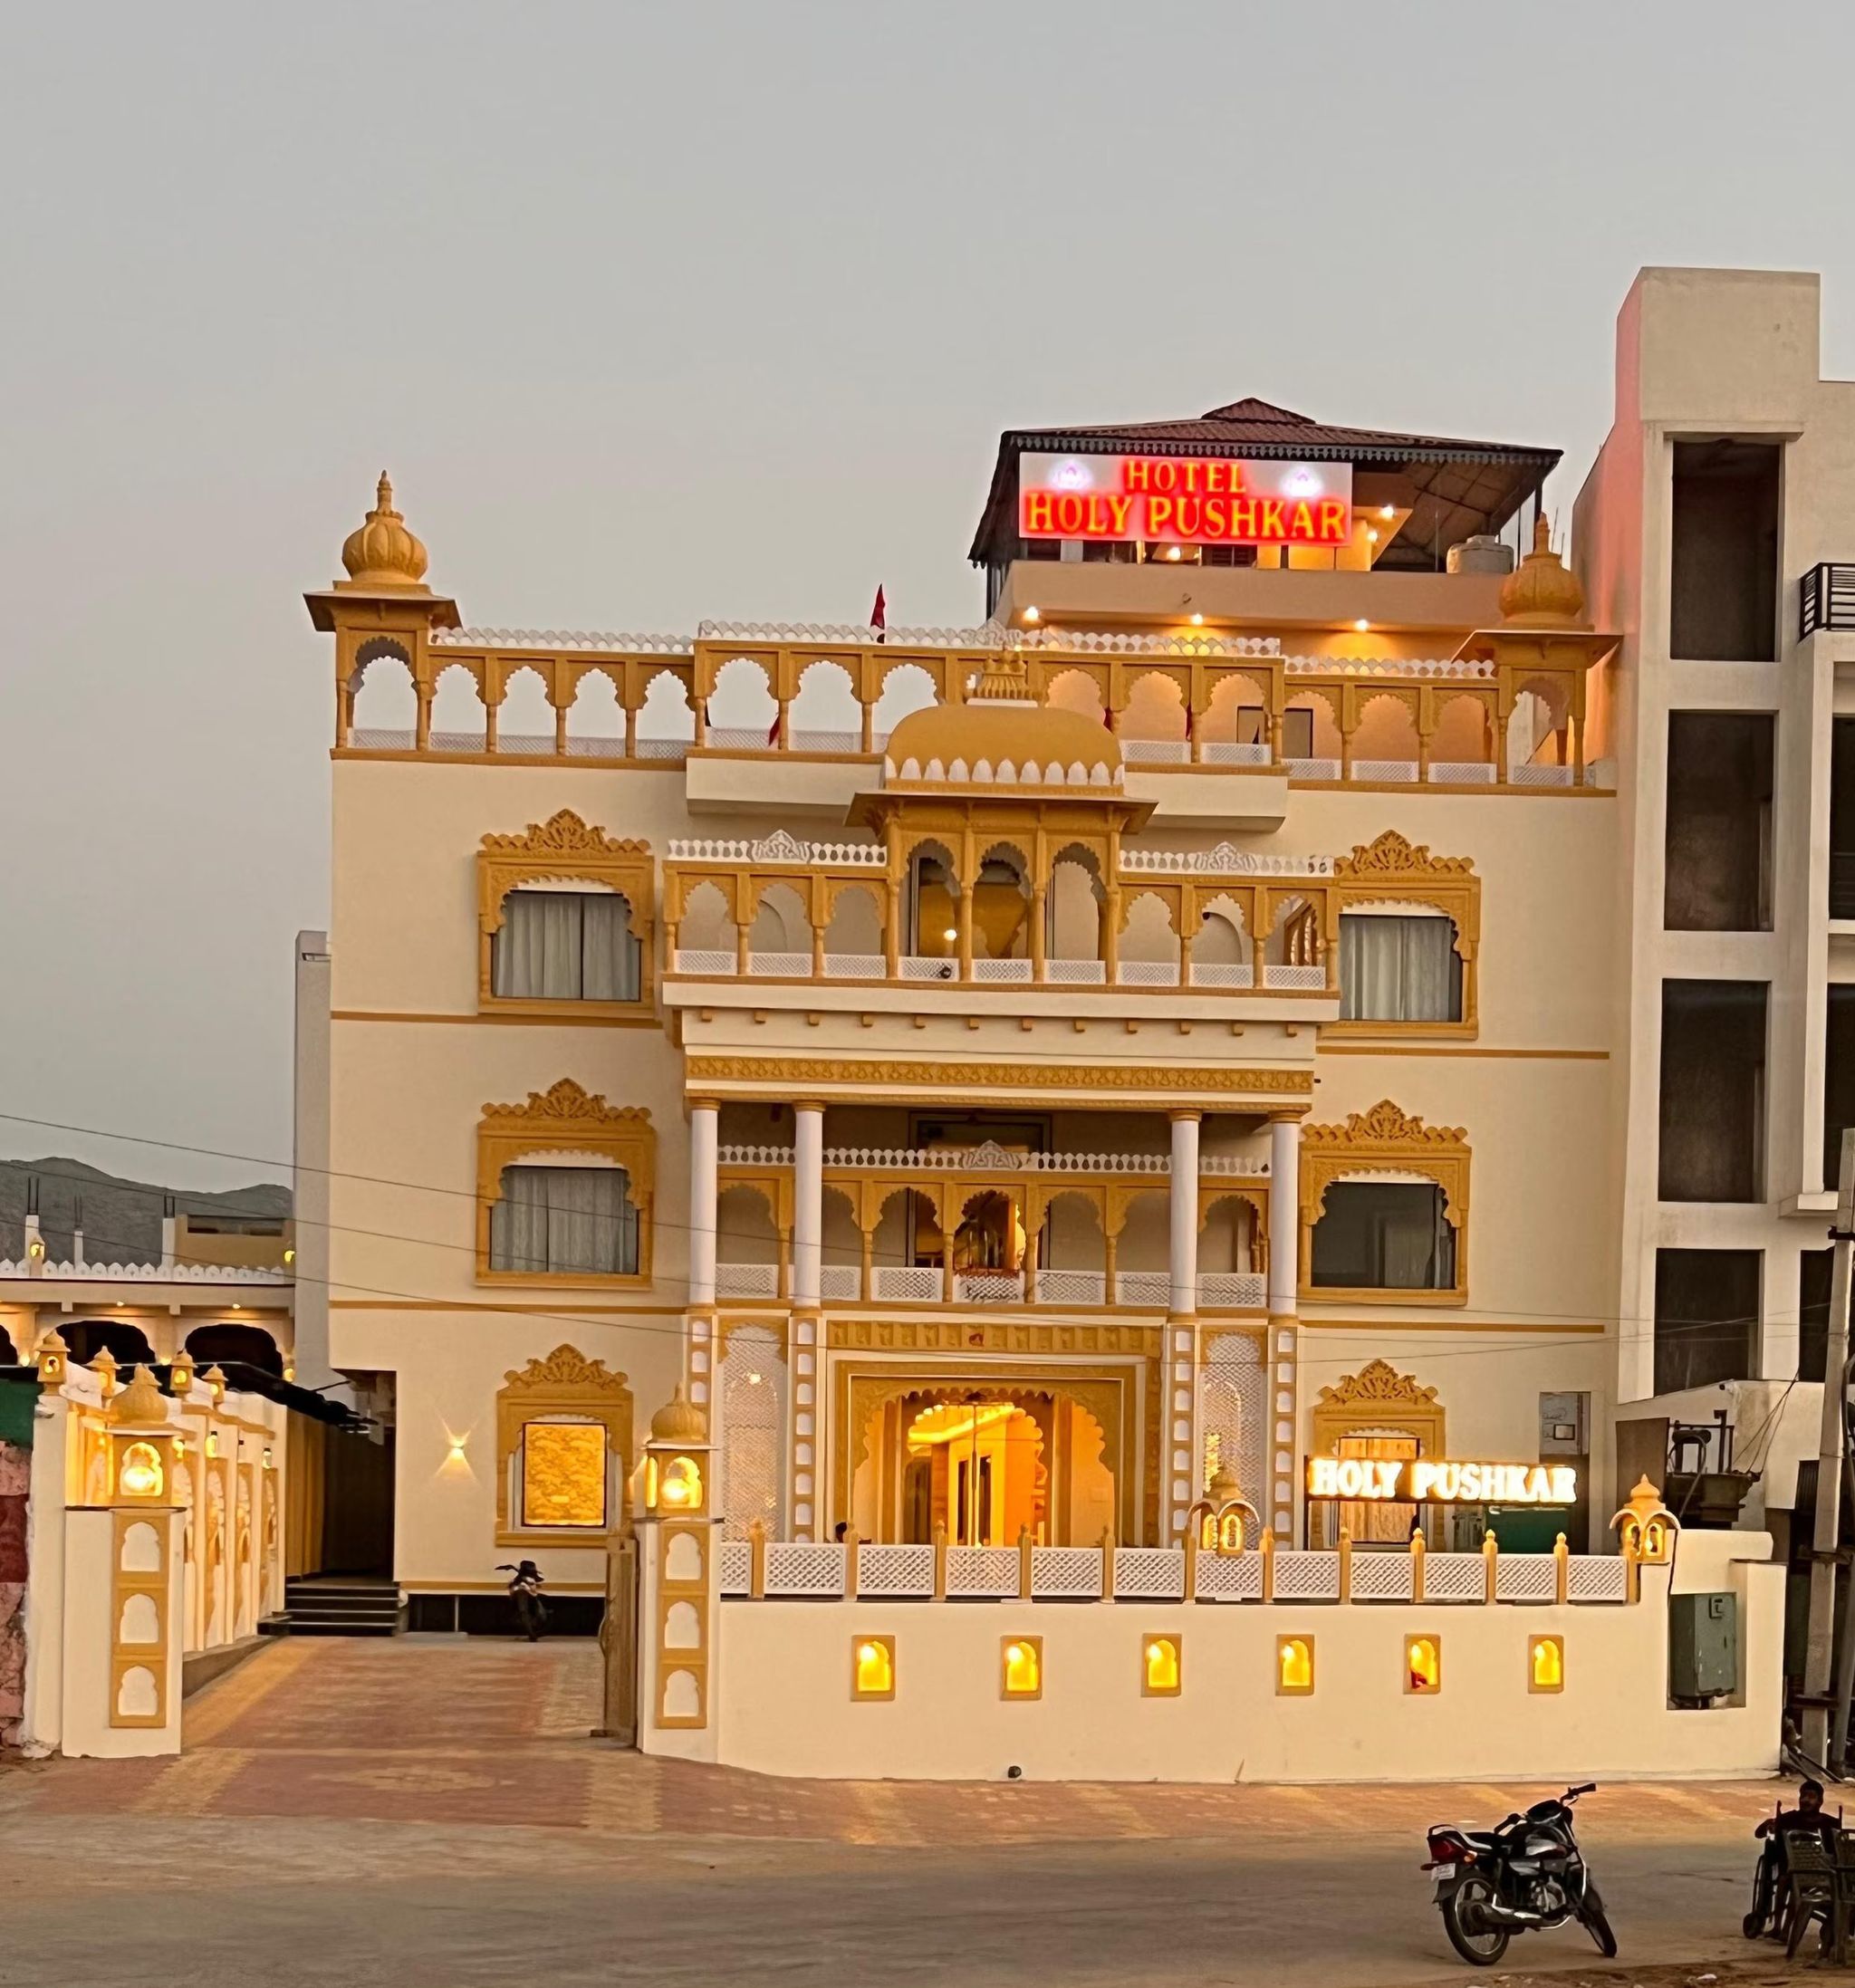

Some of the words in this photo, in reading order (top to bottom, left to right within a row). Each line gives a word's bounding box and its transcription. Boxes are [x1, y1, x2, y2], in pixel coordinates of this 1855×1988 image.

[1126, 460, 1247, 492] HOTEL
[1028, 493, 1130, 533] HOLY
[1149, 496, 1346, 540] PUSHKAR
[1308, 1458, 1402, 1498] HOLY
[1410, 1463, 1577, 1503] PUSHKAR
